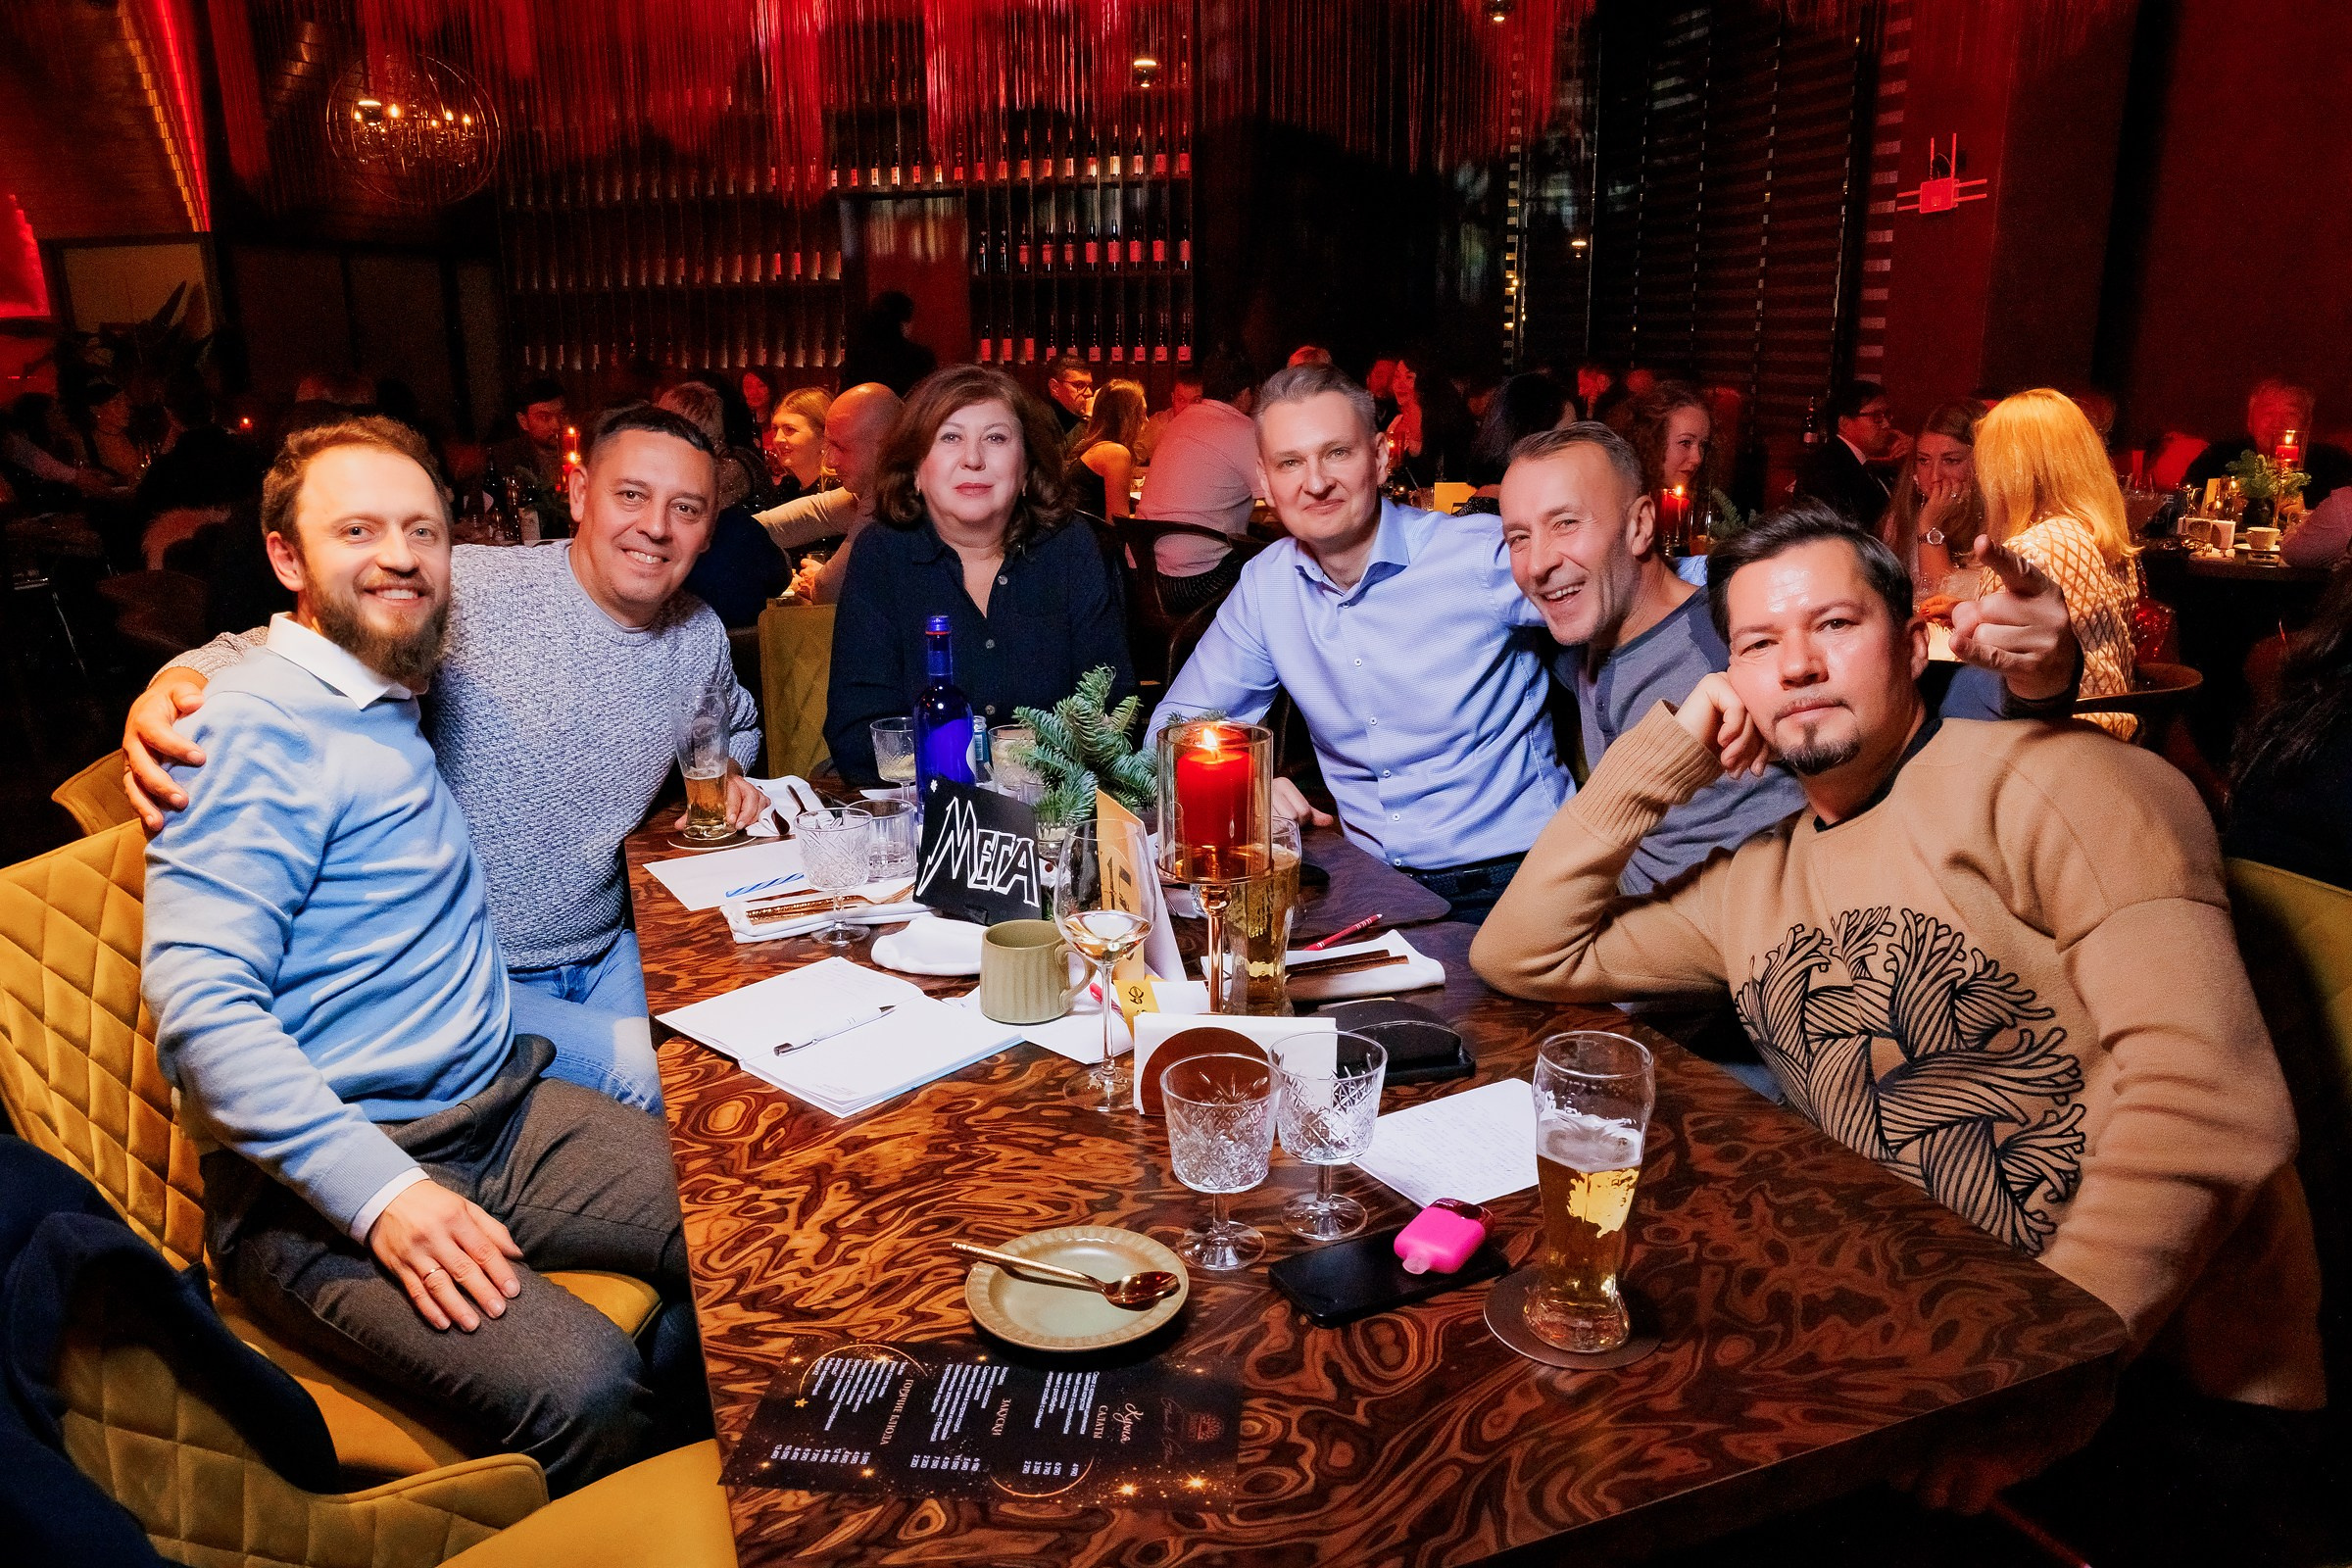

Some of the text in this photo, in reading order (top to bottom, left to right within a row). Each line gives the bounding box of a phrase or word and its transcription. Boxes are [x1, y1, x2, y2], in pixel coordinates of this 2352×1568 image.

[879, 1379, 914, 1446] ГОРЯЧИЕ БЛЮДА
[991, 1397, 1012, 1436] ЗАКУСКИ
[1093, 1405, 1108, 1439] САЛАТЫ
[1112, 1402, 1144, 1445] Кухня
